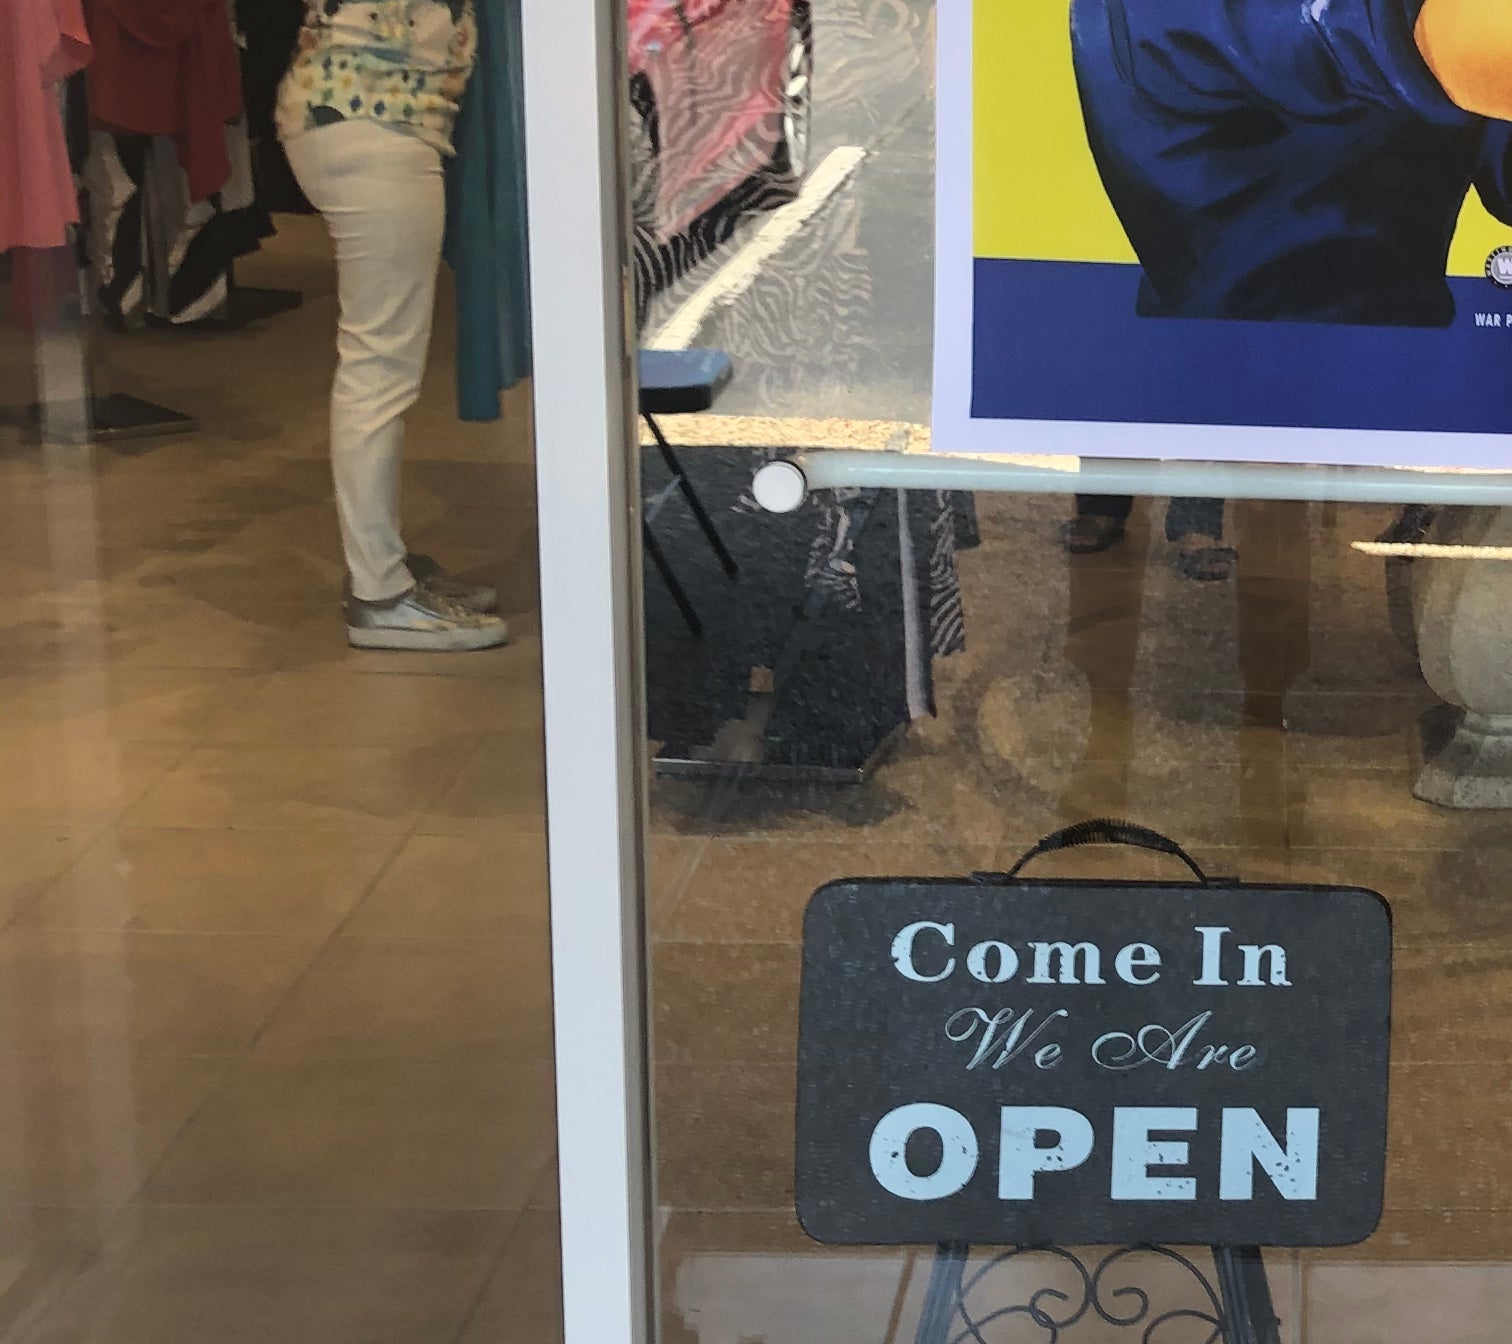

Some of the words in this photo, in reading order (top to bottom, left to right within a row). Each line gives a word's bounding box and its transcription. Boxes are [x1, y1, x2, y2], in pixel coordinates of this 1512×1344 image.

[1474, 312, 1501, 328] WAR
[889, 919, 1163, 985] Come
[1192, 926, 1293, 987] In
[944, 1007, 1069, 1071] We
[1091, 1010, 1257, 1071] Are
[868, 1102, 1320, 1201] OPEN
